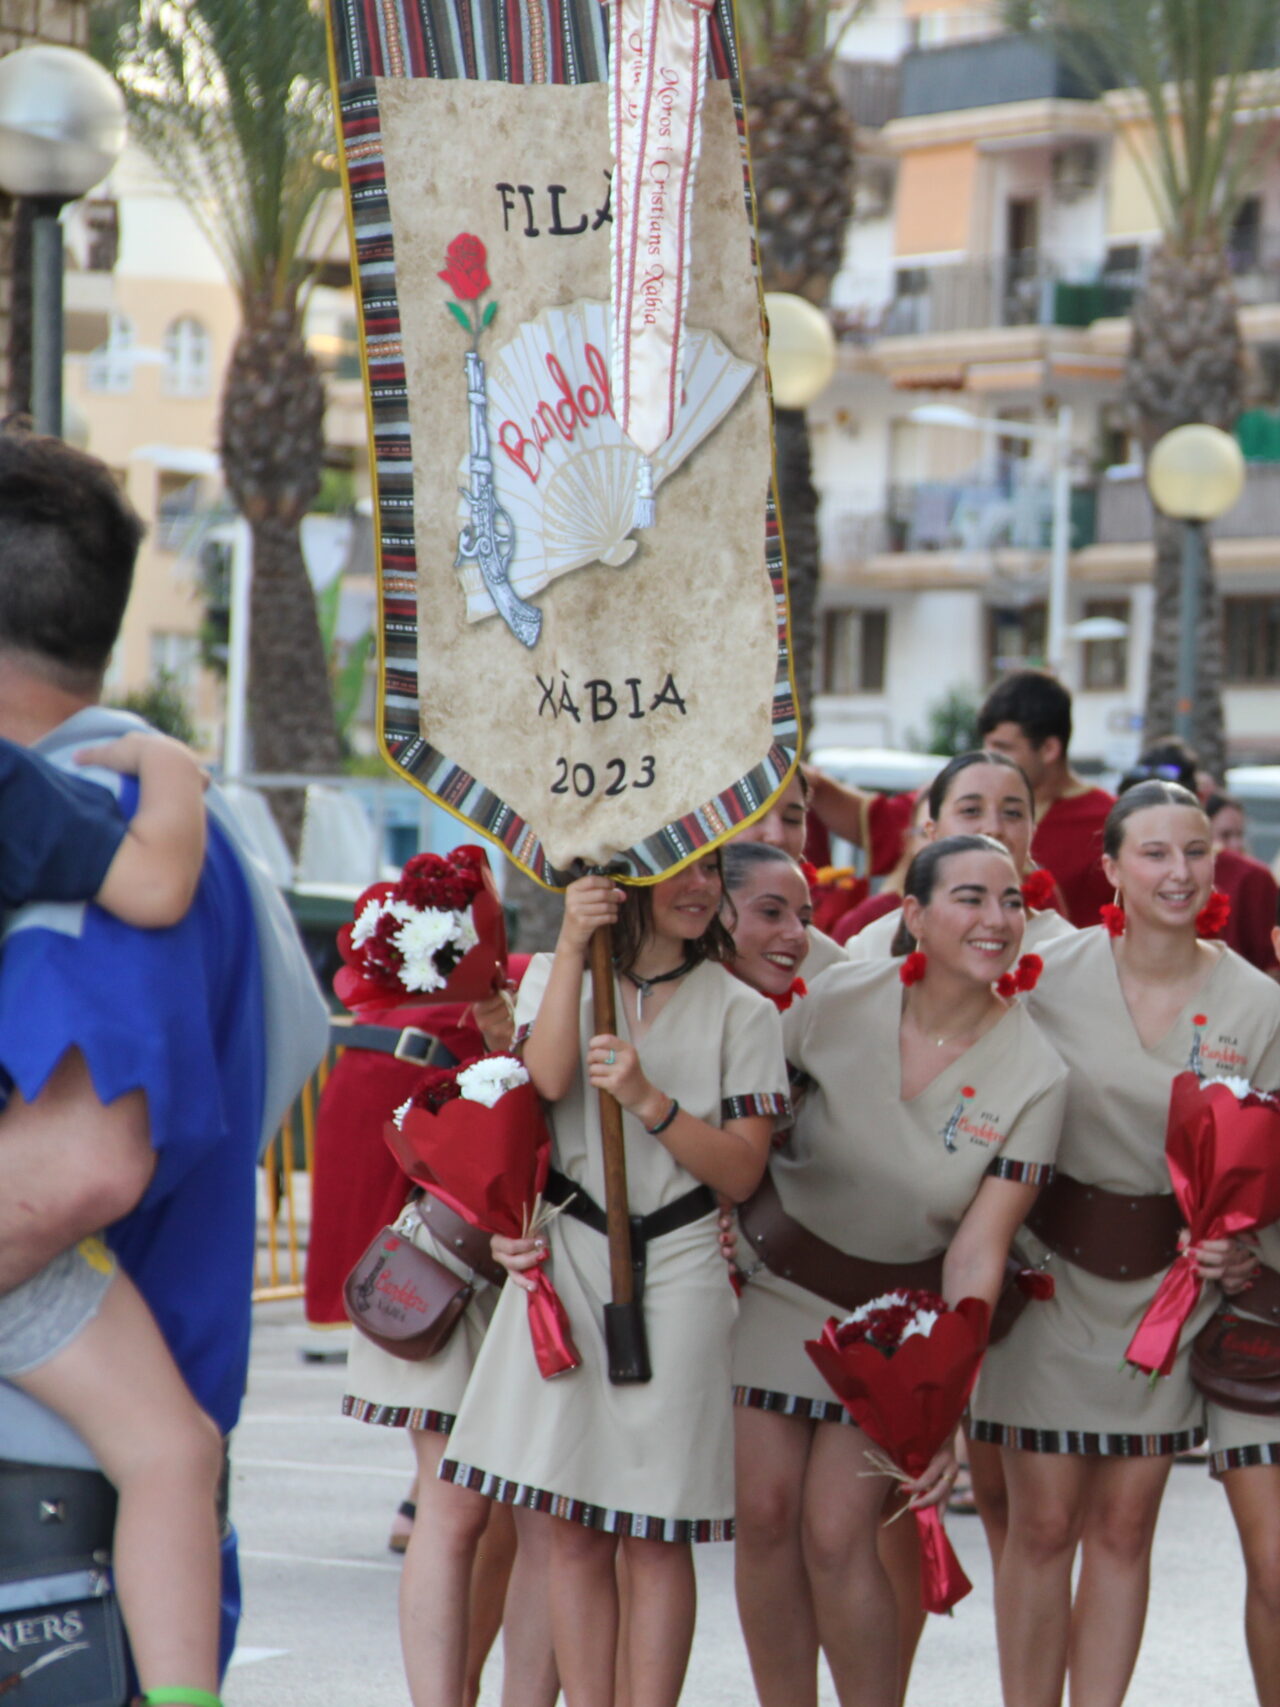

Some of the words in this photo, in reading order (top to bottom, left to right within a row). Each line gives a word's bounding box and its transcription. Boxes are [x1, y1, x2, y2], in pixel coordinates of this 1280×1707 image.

[656, 66, 680, 137] Moros
[648, 160, 671, 255] Cristians
[498, 342, 616, 484] Bandol
[536, 669, 687, 723] XÀBIA
[550, 755, 656, 798] 2023
